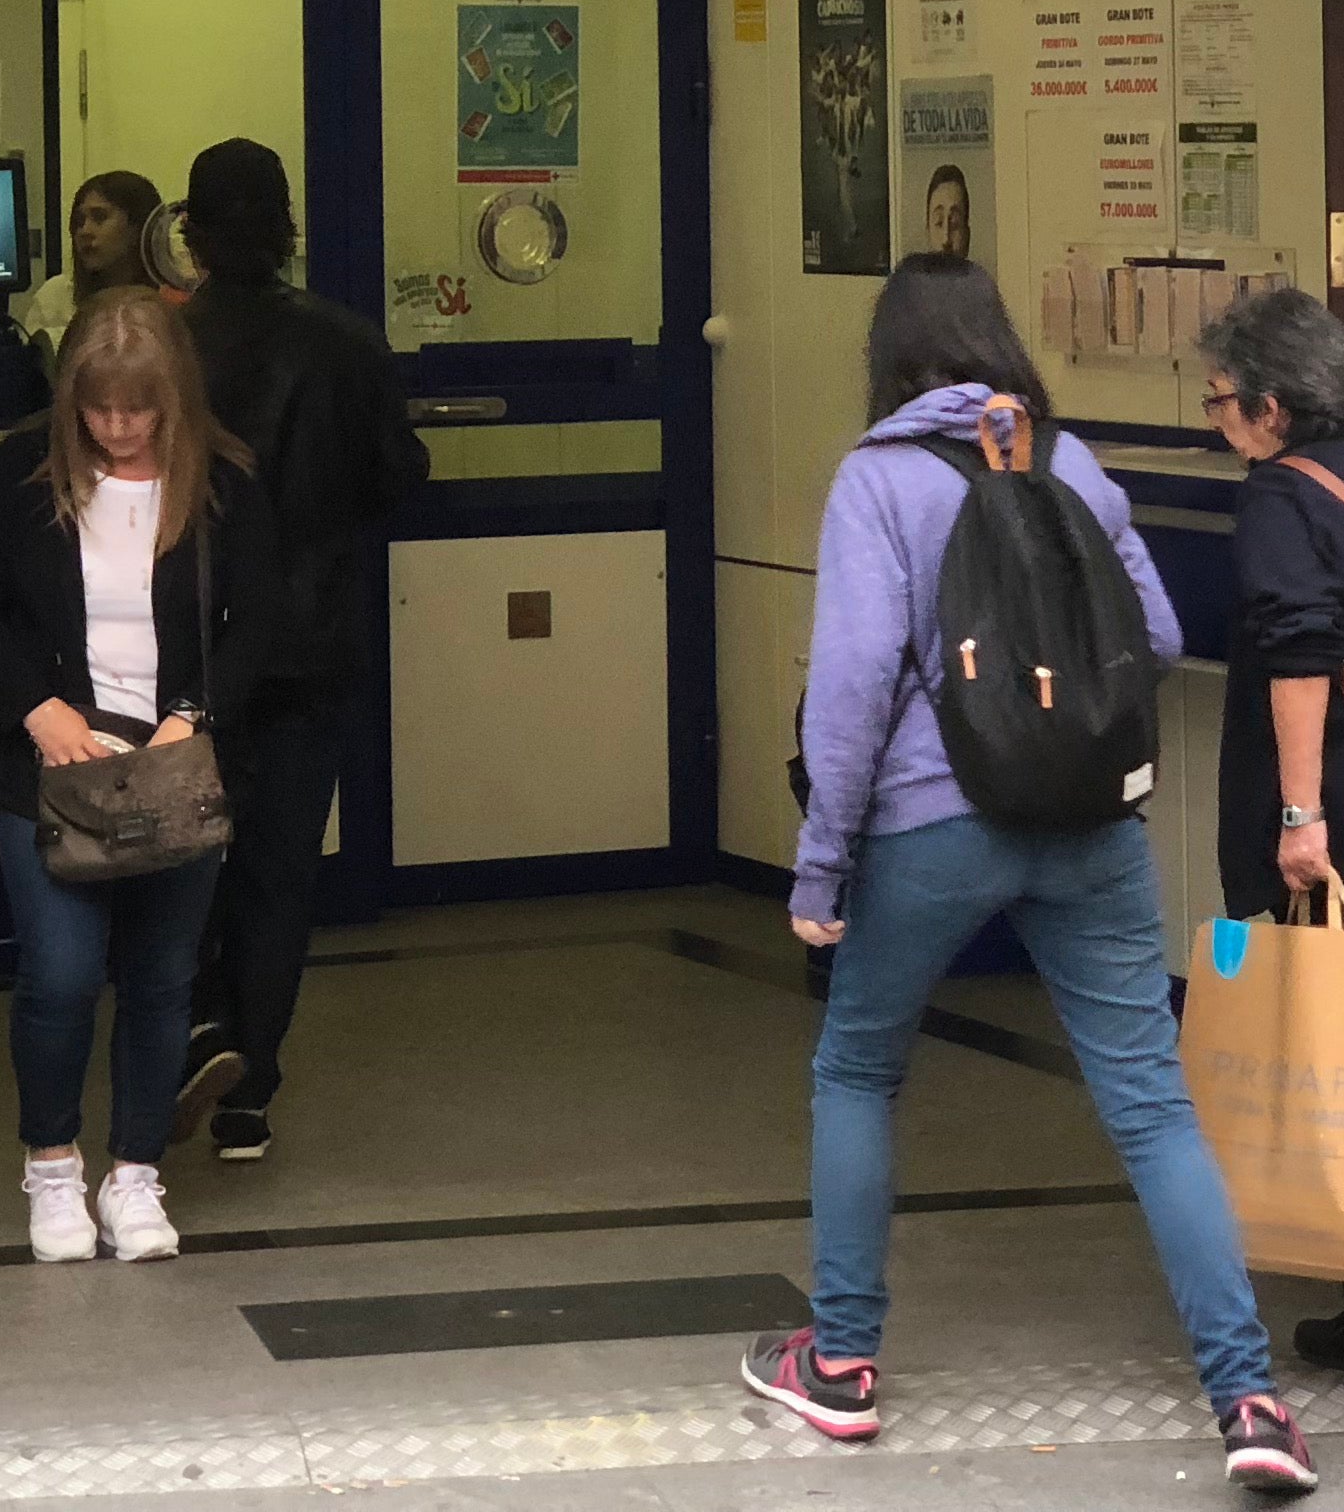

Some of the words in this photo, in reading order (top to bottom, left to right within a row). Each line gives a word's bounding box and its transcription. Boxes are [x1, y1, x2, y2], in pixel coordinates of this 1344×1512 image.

[1035, 14, 1057, 25] GRAN
[1059, 12, 1081, 25] BOTE
[1106, 8, 1131, 22] GRAN
[1132, 7, 1155, 21] BOTE
[1103, 133, 1128, 146] GRAN
[1129, 132, 1150, 146] BOTE
